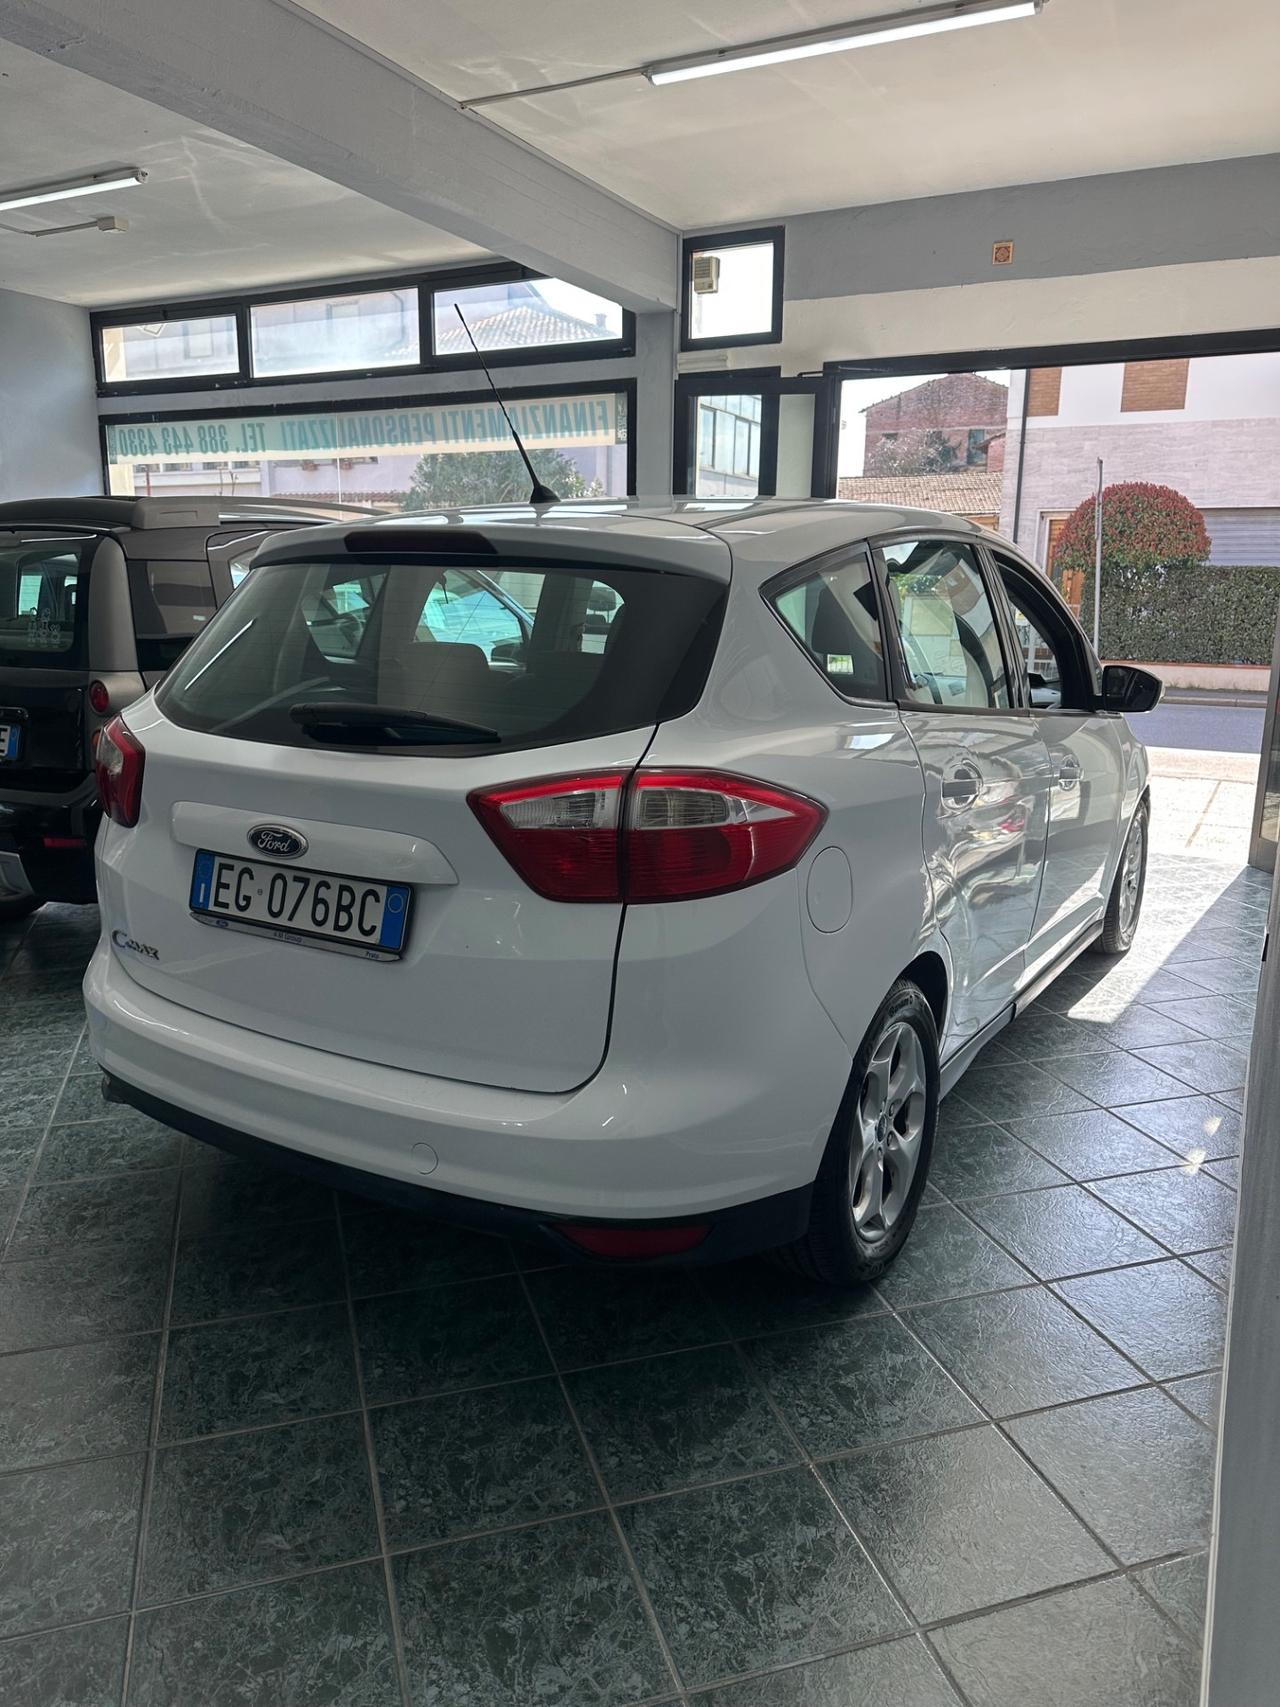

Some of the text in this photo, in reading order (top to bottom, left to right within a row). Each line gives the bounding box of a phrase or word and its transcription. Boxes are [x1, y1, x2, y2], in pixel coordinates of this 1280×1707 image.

[257, 830, 291, 852] Ford
[213, 862, 381, 937] EG 076BC
